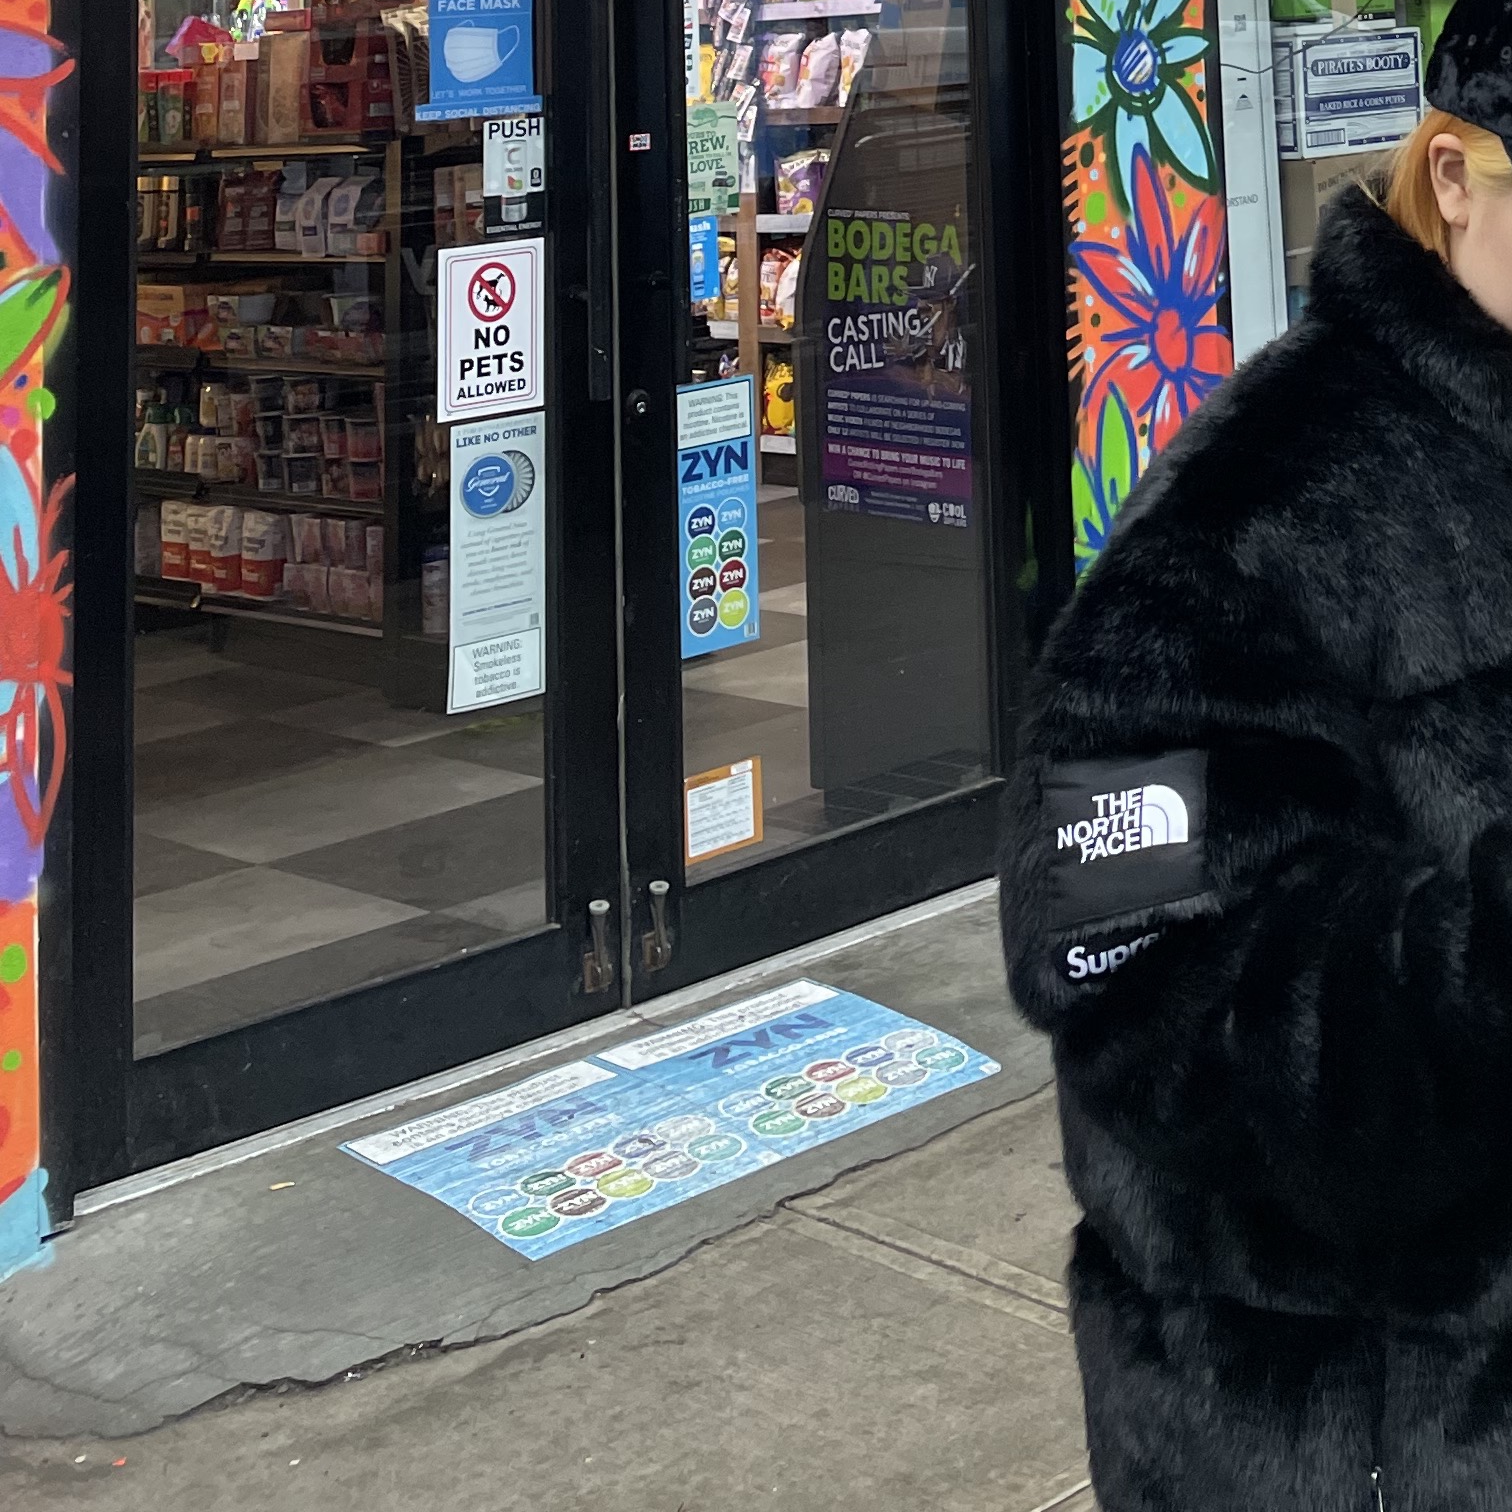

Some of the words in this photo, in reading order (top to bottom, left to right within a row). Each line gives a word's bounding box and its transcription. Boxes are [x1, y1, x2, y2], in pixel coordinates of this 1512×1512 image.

[437, 0, 475, 12] FACE
[1366, 55, 1404, 71] BOOTY
[1364, 97, 1384, 107] CORN
[489, 119, 540, 139] PUSH
[689, 135, 730, 154] REW,
[689, 220, 711, 233] ush
[827, 219, 962, 265] BODEGA
[827, 261, 909, 306] BARS
[474, 324, 510, 349] NO
[827, 308, 921, 345] CASTING
[460, 351, 524, 380] PETS
[829, 342, 885, 373] CALL
[457, 378, 526, 400] ALLOWED
[456, 435, 481, 448] LIKE
[483, 432, 499, 444] NO
[502, 425, 537, 439] OTHER
[681, 441, 749, 484] ZYN
[682, 473, 749, 495] TOBACCO-FREE
[691, 514, 713, 529] ZYN
[720, 508, 742, 522] ZYN
[692, 545, 713, 559] ZYN
[721, 538, 743, 552] ZYN
[692, 575, 714, 590] ZYN
[722, 568, 744, 583] ZYN
[692, 606, 714, 622] ZYN
[723, 598, 744, 613] ZYN
[1092, 787, 1143, 817] THE
[1057, 806, 1141, 849] NORTH
[1080, 827, 1141, 864] FACE
[686, 1011, 835, 1071] ZYN
